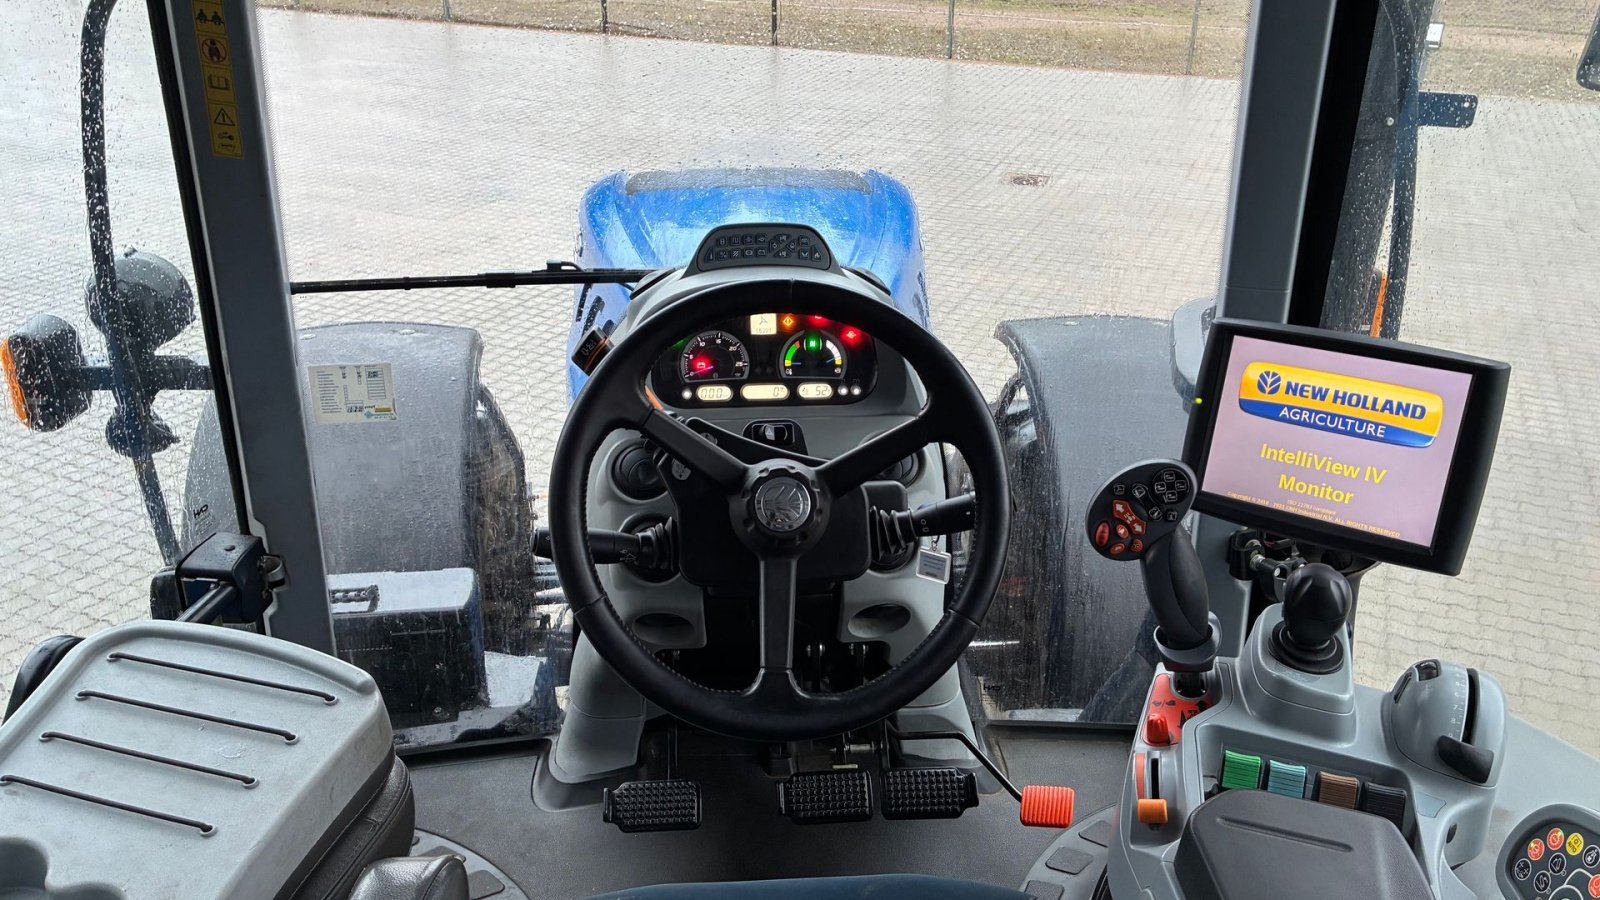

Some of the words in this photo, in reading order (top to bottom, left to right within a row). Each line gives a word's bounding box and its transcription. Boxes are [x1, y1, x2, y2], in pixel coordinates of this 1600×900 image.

[1284, 381, 1329, 402] NEW
[1332, 389, 1427, 420] HOLLAND
[1278, 405, 1387, 438] AGRICULTURE
[1260, 442, 1361, 479] IntelliView
[1364, 465, 1388, 485] IV
[1278, 473, 1354, 505] Monitor
[1346, 520, 1368, 530] RIGHTS
[1369, 525, 1401, 538] RESERVED
